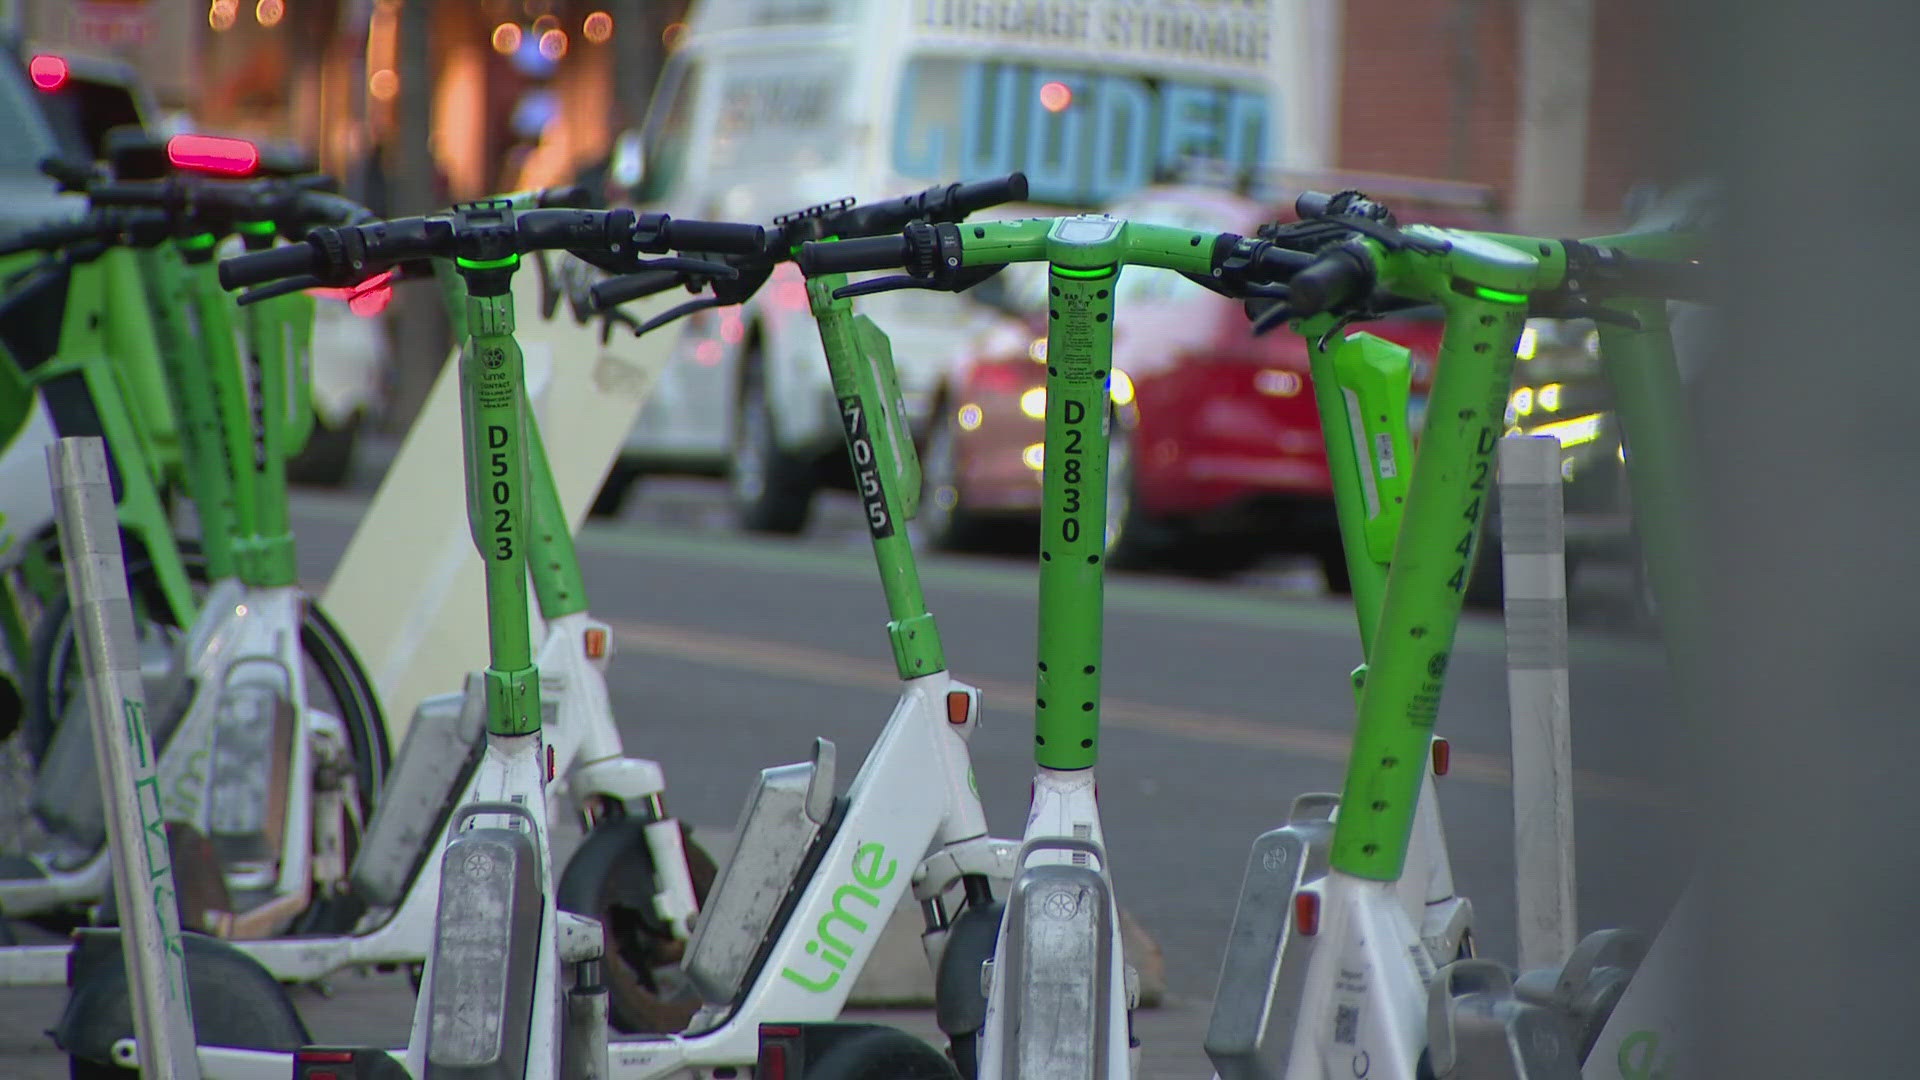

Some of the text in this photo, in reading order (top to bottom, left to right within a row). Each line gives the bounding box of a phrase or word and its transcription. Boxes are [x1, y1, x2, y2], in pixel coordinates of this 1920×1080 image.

[488, 425, 513, 561] D5023
[844, 407, 887, 529] 7055
[1062, 400, 1086, 543] D2830
[1447, 427, 1497, 592] D2444
[782, 842, 898, 993] Lime
